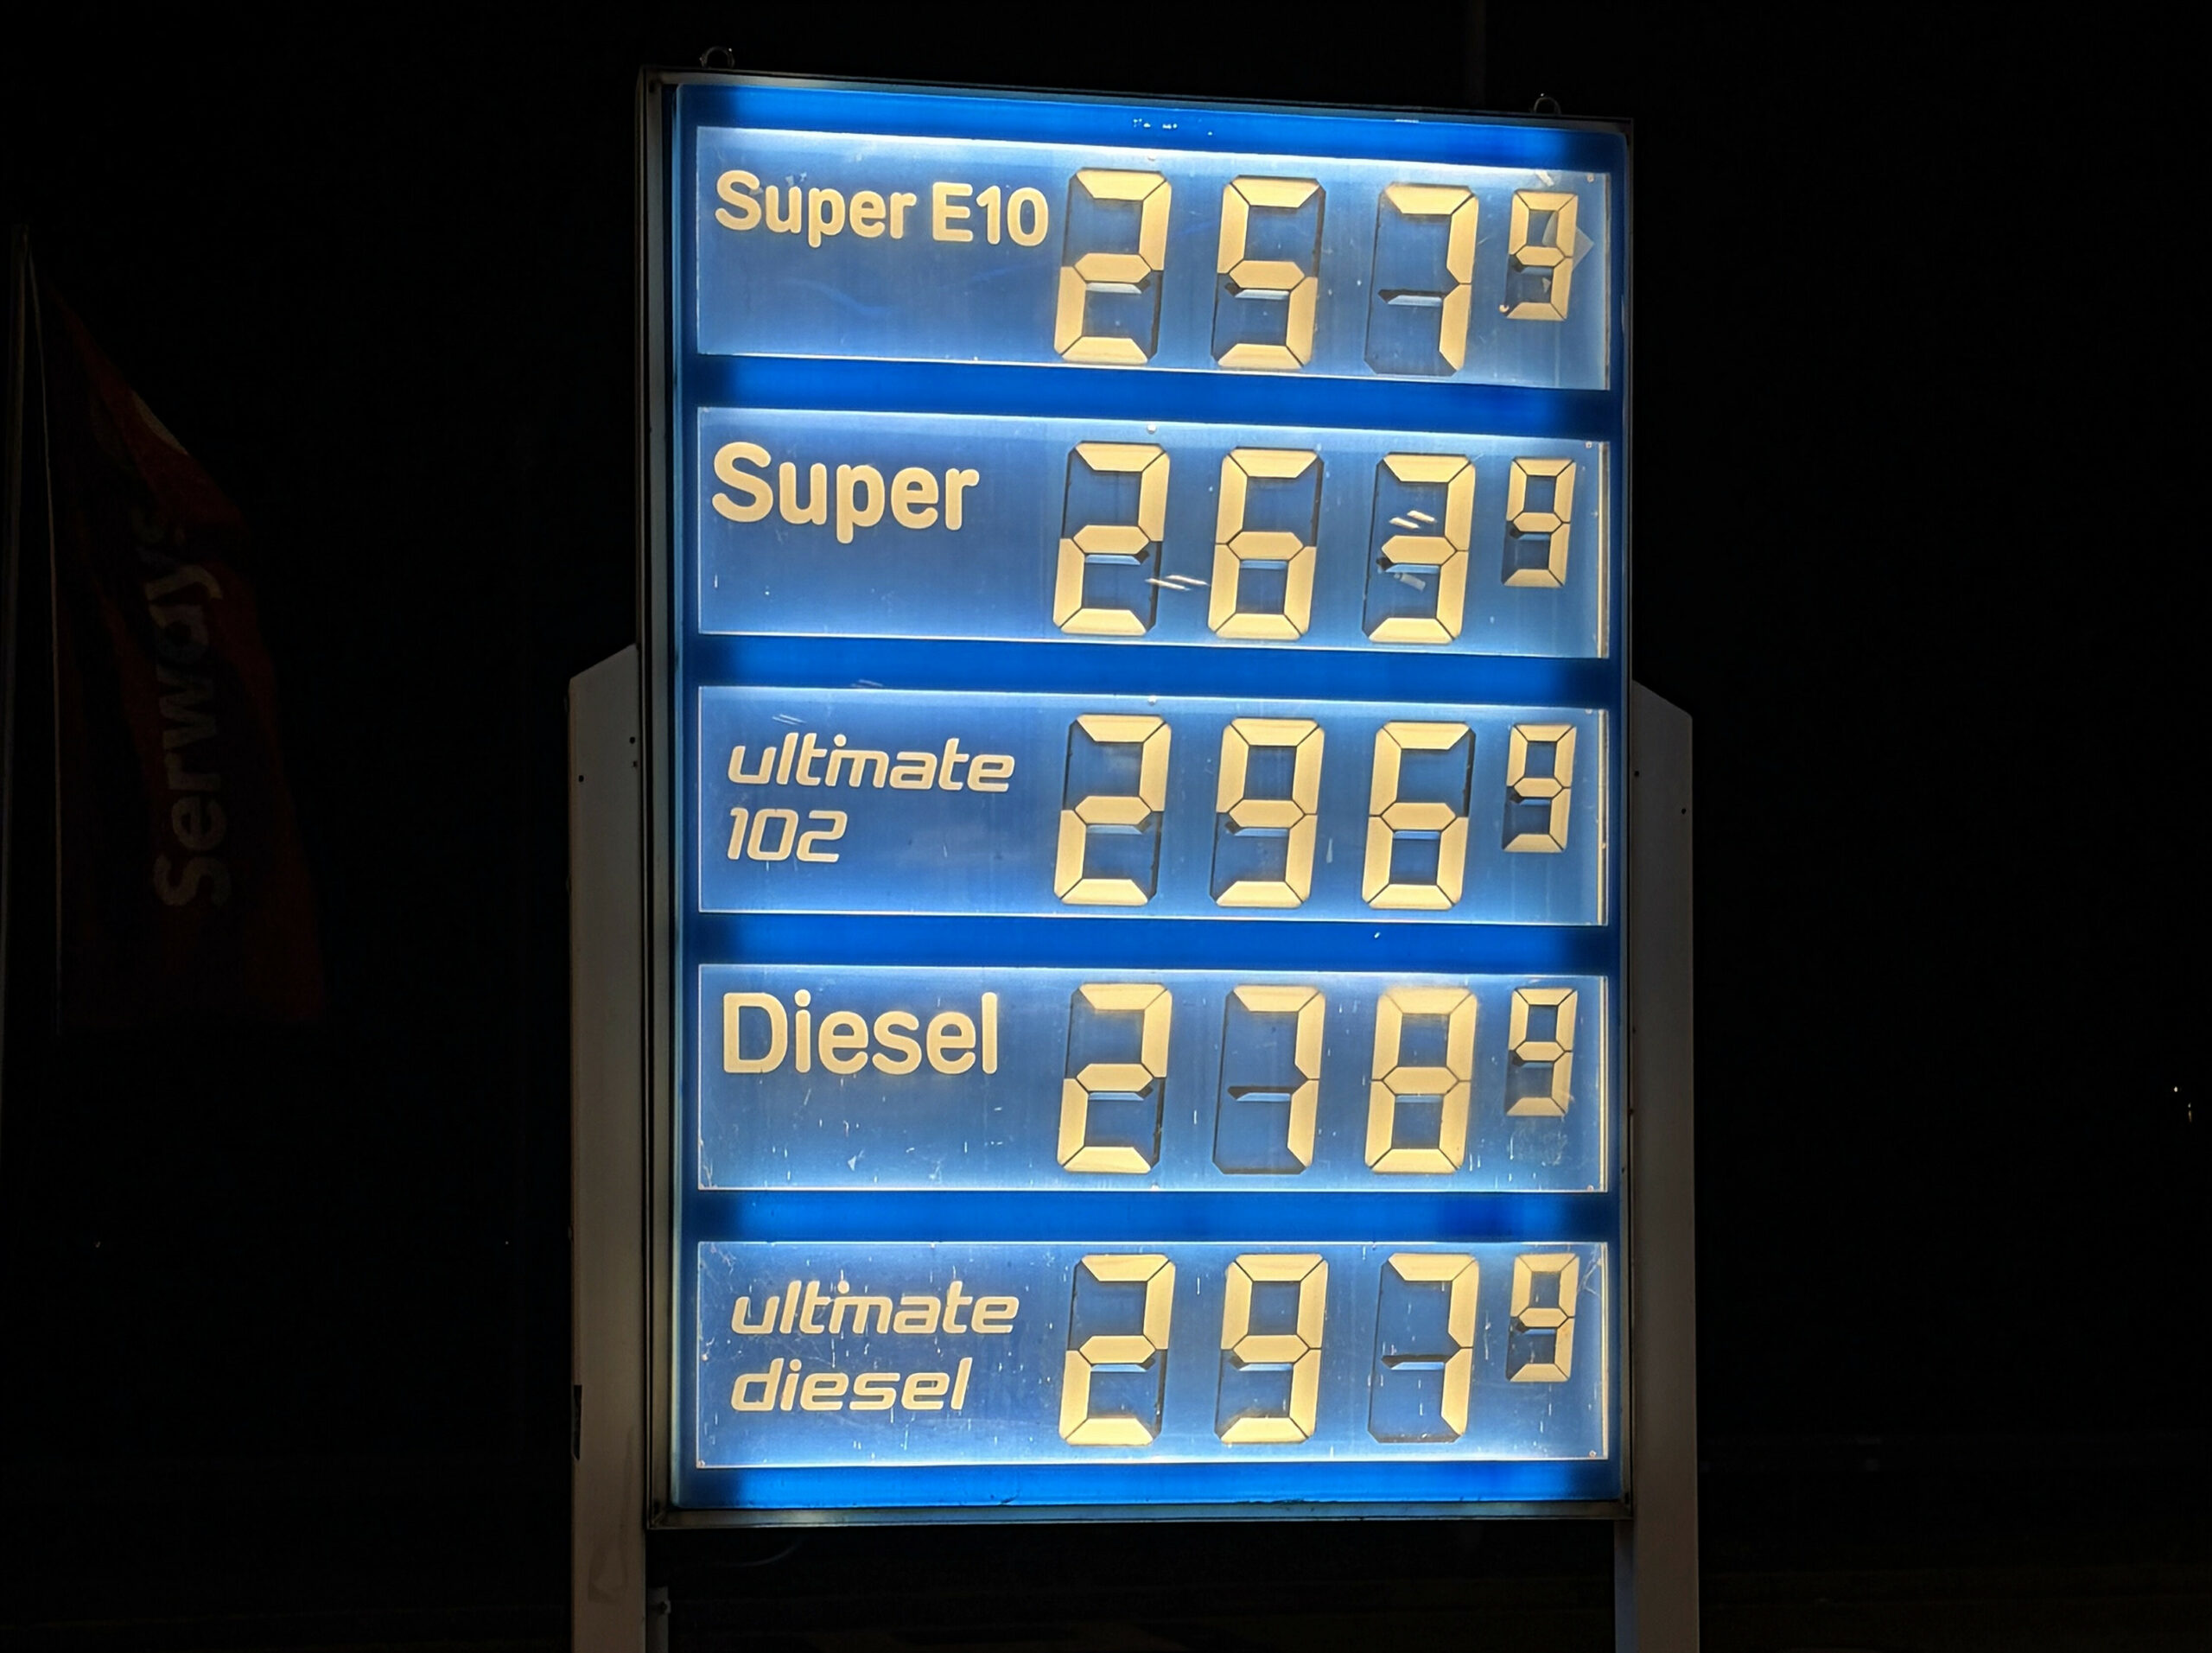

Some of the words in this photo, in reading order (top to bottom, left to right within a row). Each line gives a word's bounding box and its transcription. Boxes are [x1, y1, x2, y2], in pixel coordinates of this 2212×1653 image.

[715, 169, 917, 248] Super
[932, 182, 1050, 248] E10
[712, 442, 980, 544] Super
[728, 733, 1015, 793] ultimate
[728, 808, 849, 862] 102
[722, 990, 998, 1075] Diesel
[731, 1281, 1020, 1335] ultimate
[731, 1357, 971, 1412] diesel
